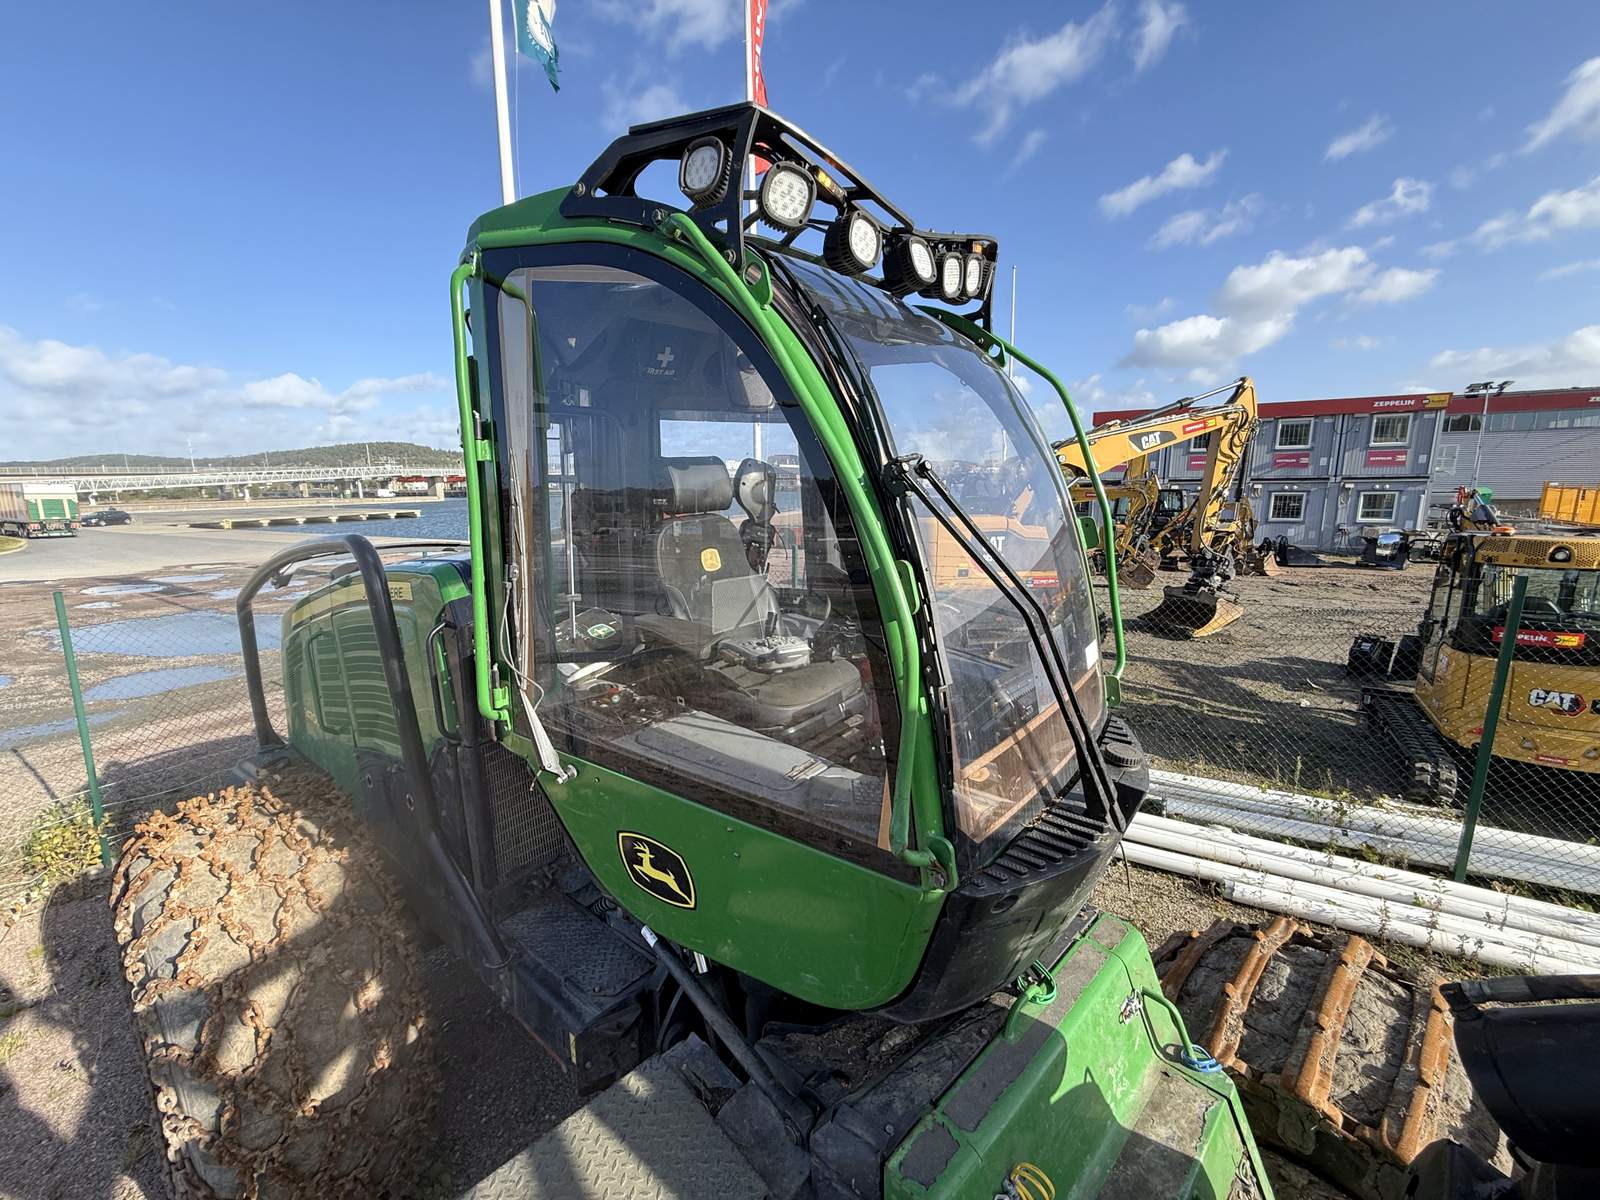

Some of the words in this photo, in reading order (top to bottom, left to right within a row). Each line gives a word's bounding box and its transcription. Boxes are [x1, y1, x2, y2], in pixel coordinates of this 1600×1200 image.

[1373, 399, 1415, 407] ZEPPELIN
[1141, 432, 1161, 449] CAT
[1498, 631, 1548, 643] ZPELIN
[1529, 689, 1576, 712] CAT
